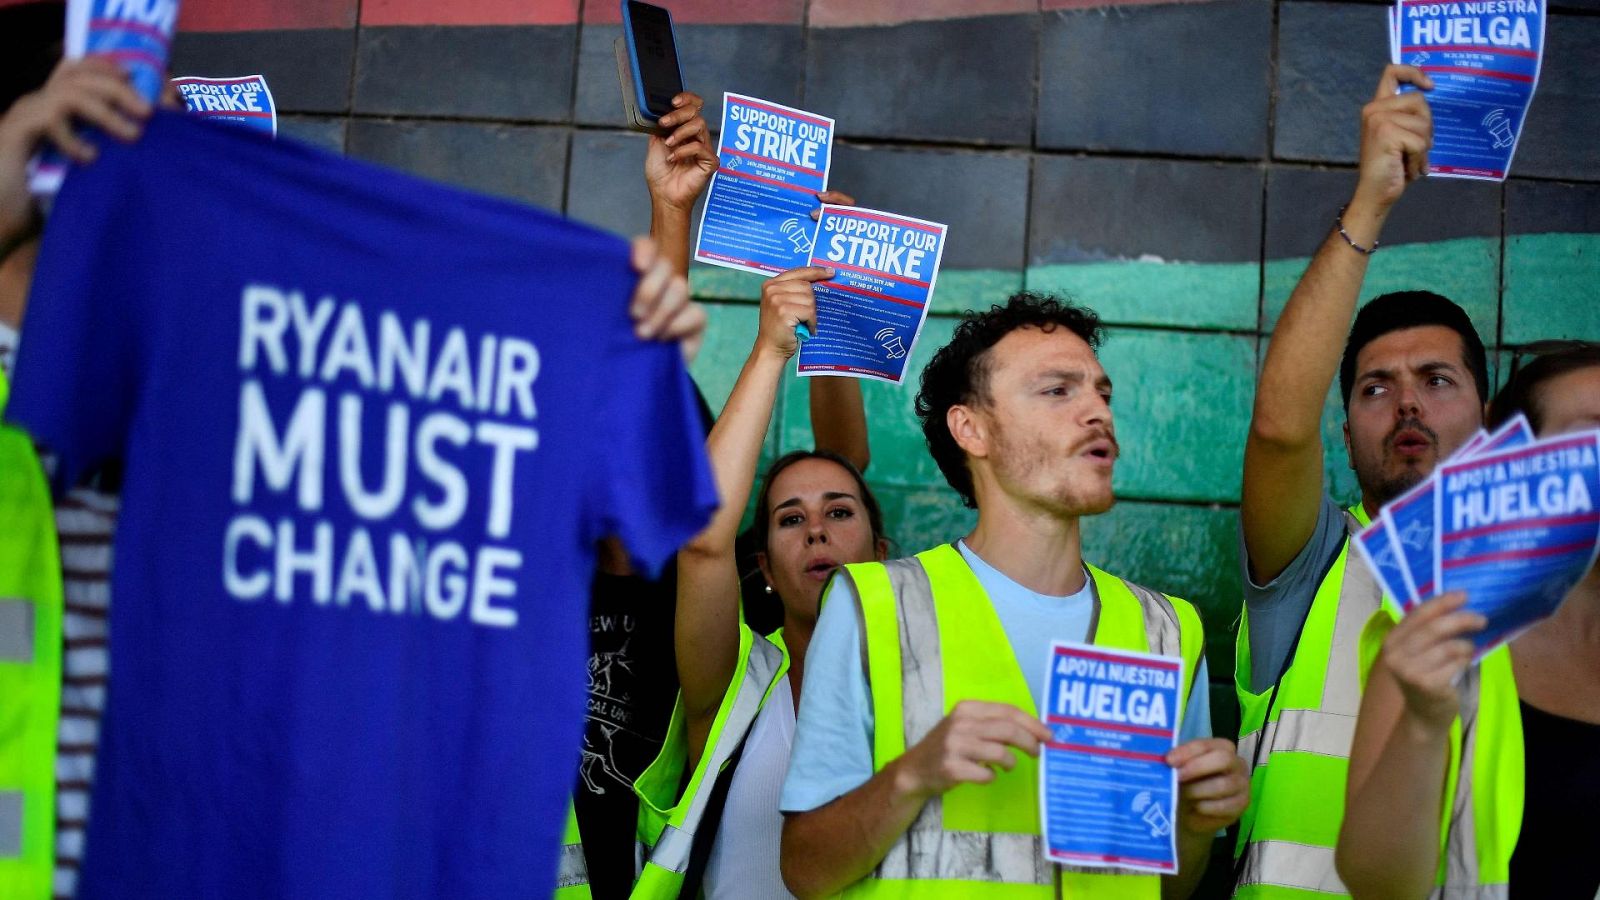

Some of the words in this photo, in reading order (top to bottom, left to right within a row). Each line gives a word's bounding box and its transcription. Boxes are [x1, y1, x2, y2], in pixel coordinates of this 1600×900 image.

[1408, 4, 1462, 18] APOYA
[1465, 1, 1538, 16] NUESTRA
[1412, 16, 1531, 48] HUELGA
[177, 84, 227, 95] PPORT
[231, 82, 263, 93] OUR
[730, 104, 796, 135] SUPPORT
[799, 123, 828, 145] OUR
[734, 124, 819, 170] STRIKE
[824, 216, 900, 243] SUPPORT
[903, 229, 937, 251] OUR
[827, 233, 925, 279] STRIKE
[238, 283, 541, 420] RYANAIR
[232, 379, 539, 539] MUST
[1447, 463, 1508, 492] APOYA
[1510, 446, 1597, 477] NUESTRA
[1452, 473, 1593, 531] HUELGA
[222, 514, 523, 627] CHANGE
[1056, 657, 1106, 680] APOYA
[1109, 661, 1176, 689] NUESTRA
[586, 698, 607, 715] CAL
[1057, 679, 1168, 727] HUELGA
